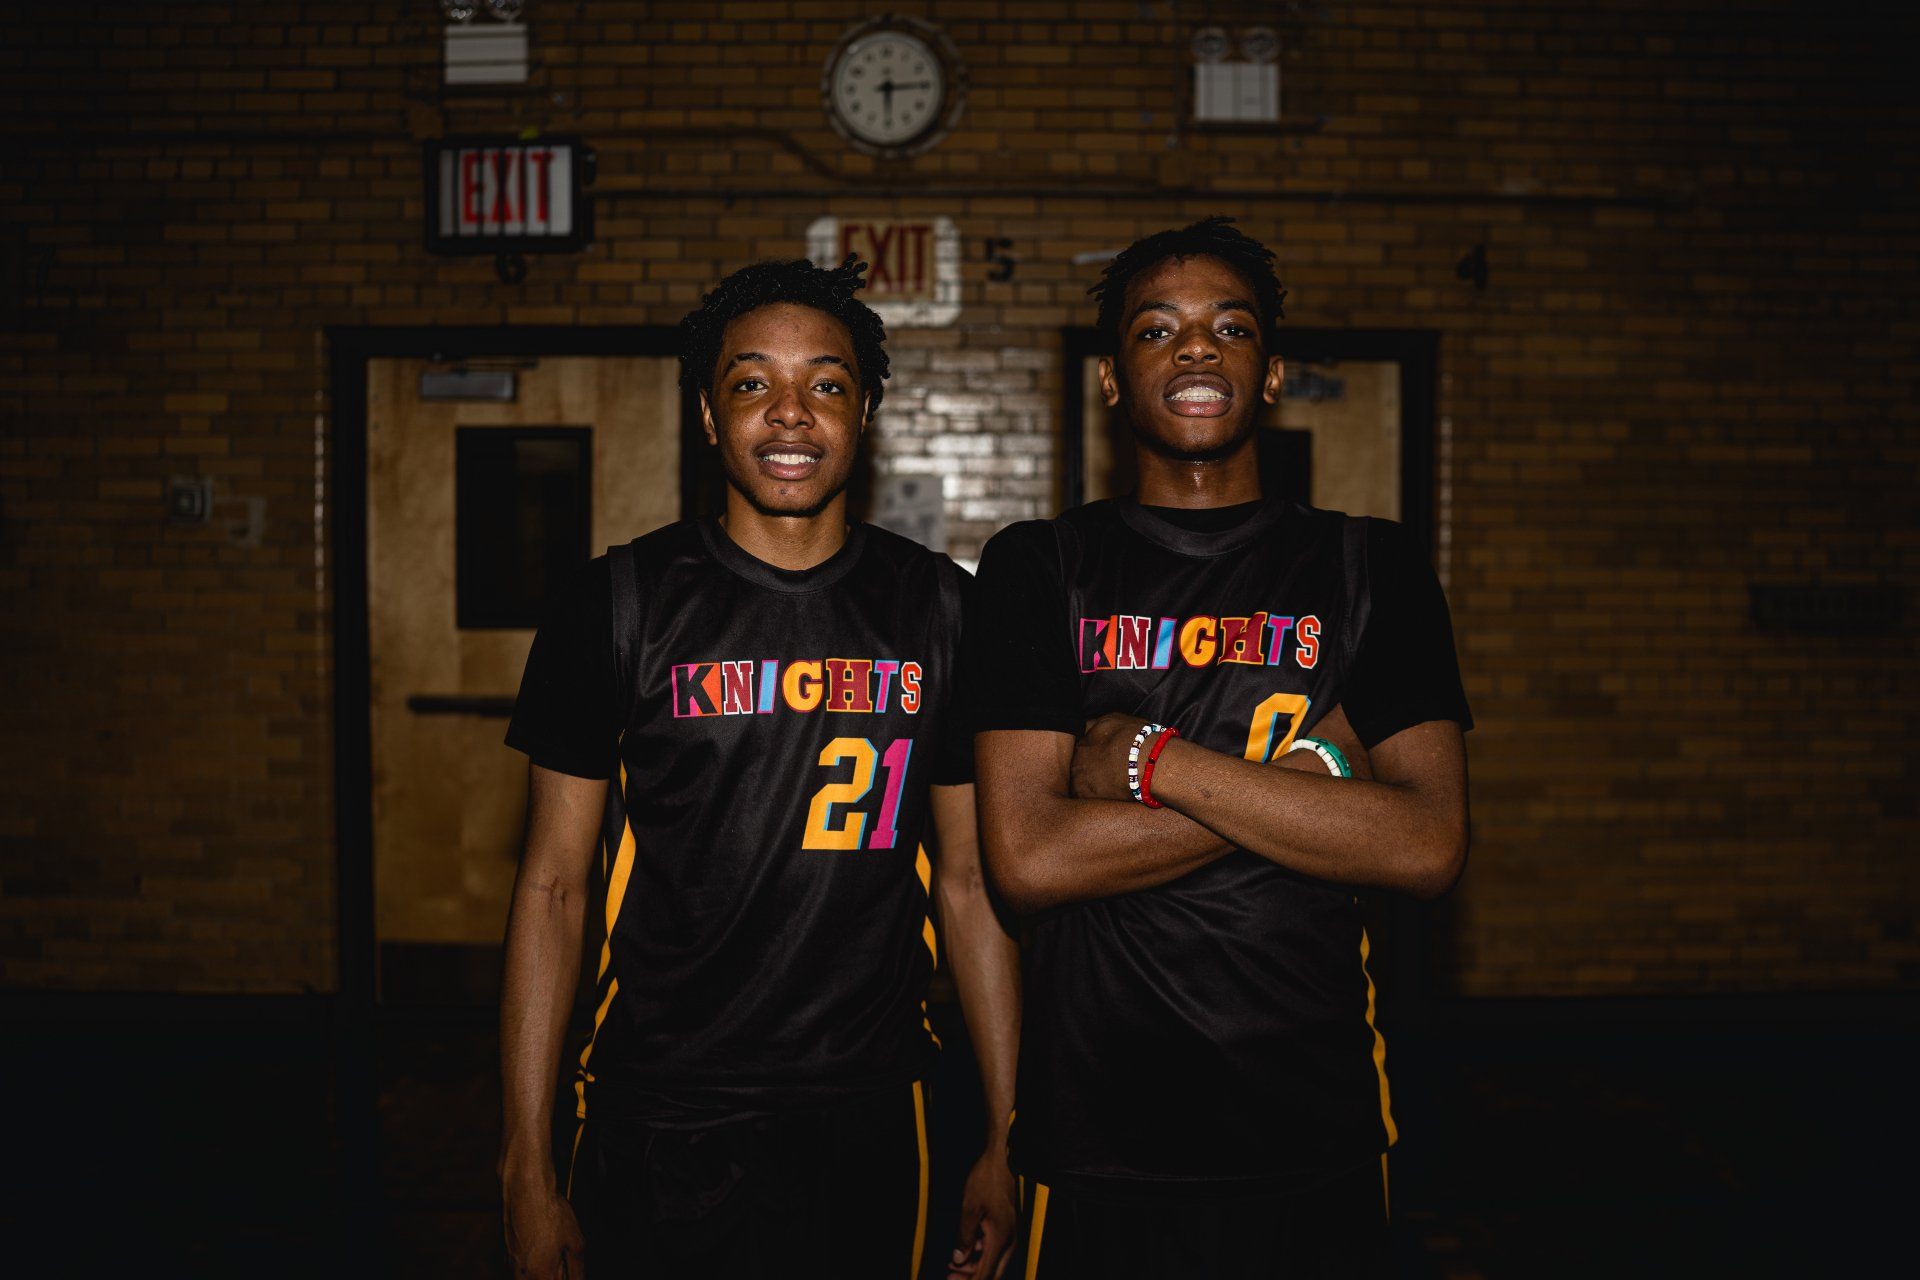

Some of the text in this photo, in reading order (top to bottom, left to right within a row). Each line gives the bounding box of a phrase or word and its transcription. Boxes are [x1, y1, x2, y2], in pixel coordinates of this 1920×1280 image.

[462, 151, 554, 223] EXIT
[986, 237, 1015, 282] 5
[1079, 611, 1321, 674] KNIGHTS
[671, 658, 922, 718] KNIGHTS
[801, 737, 913, 850] 21
